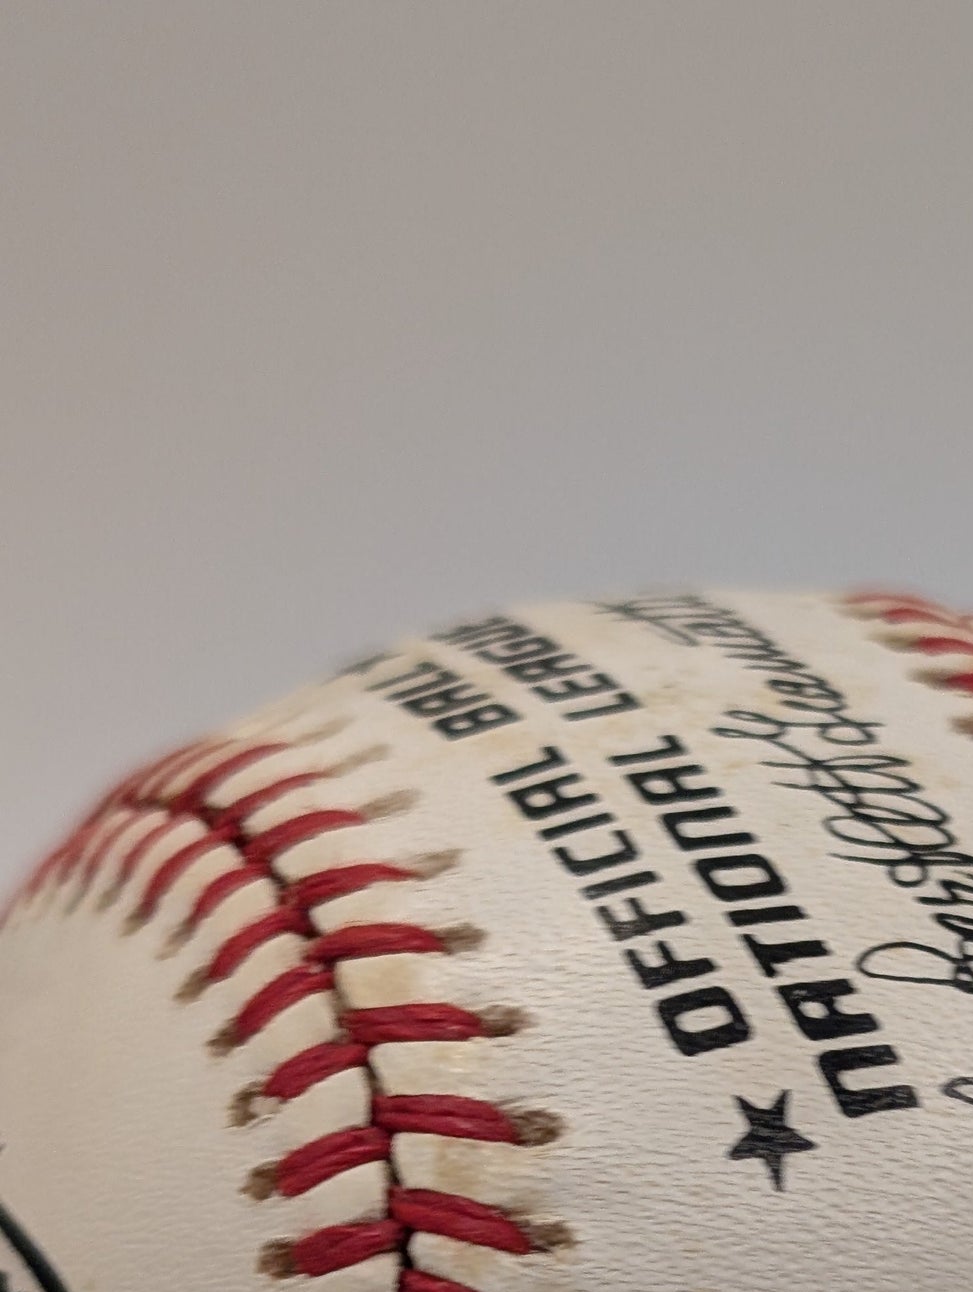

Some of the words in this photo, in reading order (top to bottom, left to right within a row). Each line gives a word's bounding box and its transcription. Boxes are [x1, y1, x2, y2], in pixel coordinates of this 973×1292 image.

[363, 660, 526, 742] BALL
[488, 745, 754, 1057] OFFICIAL
[605, 733, 920, 1118] NATIONAL
